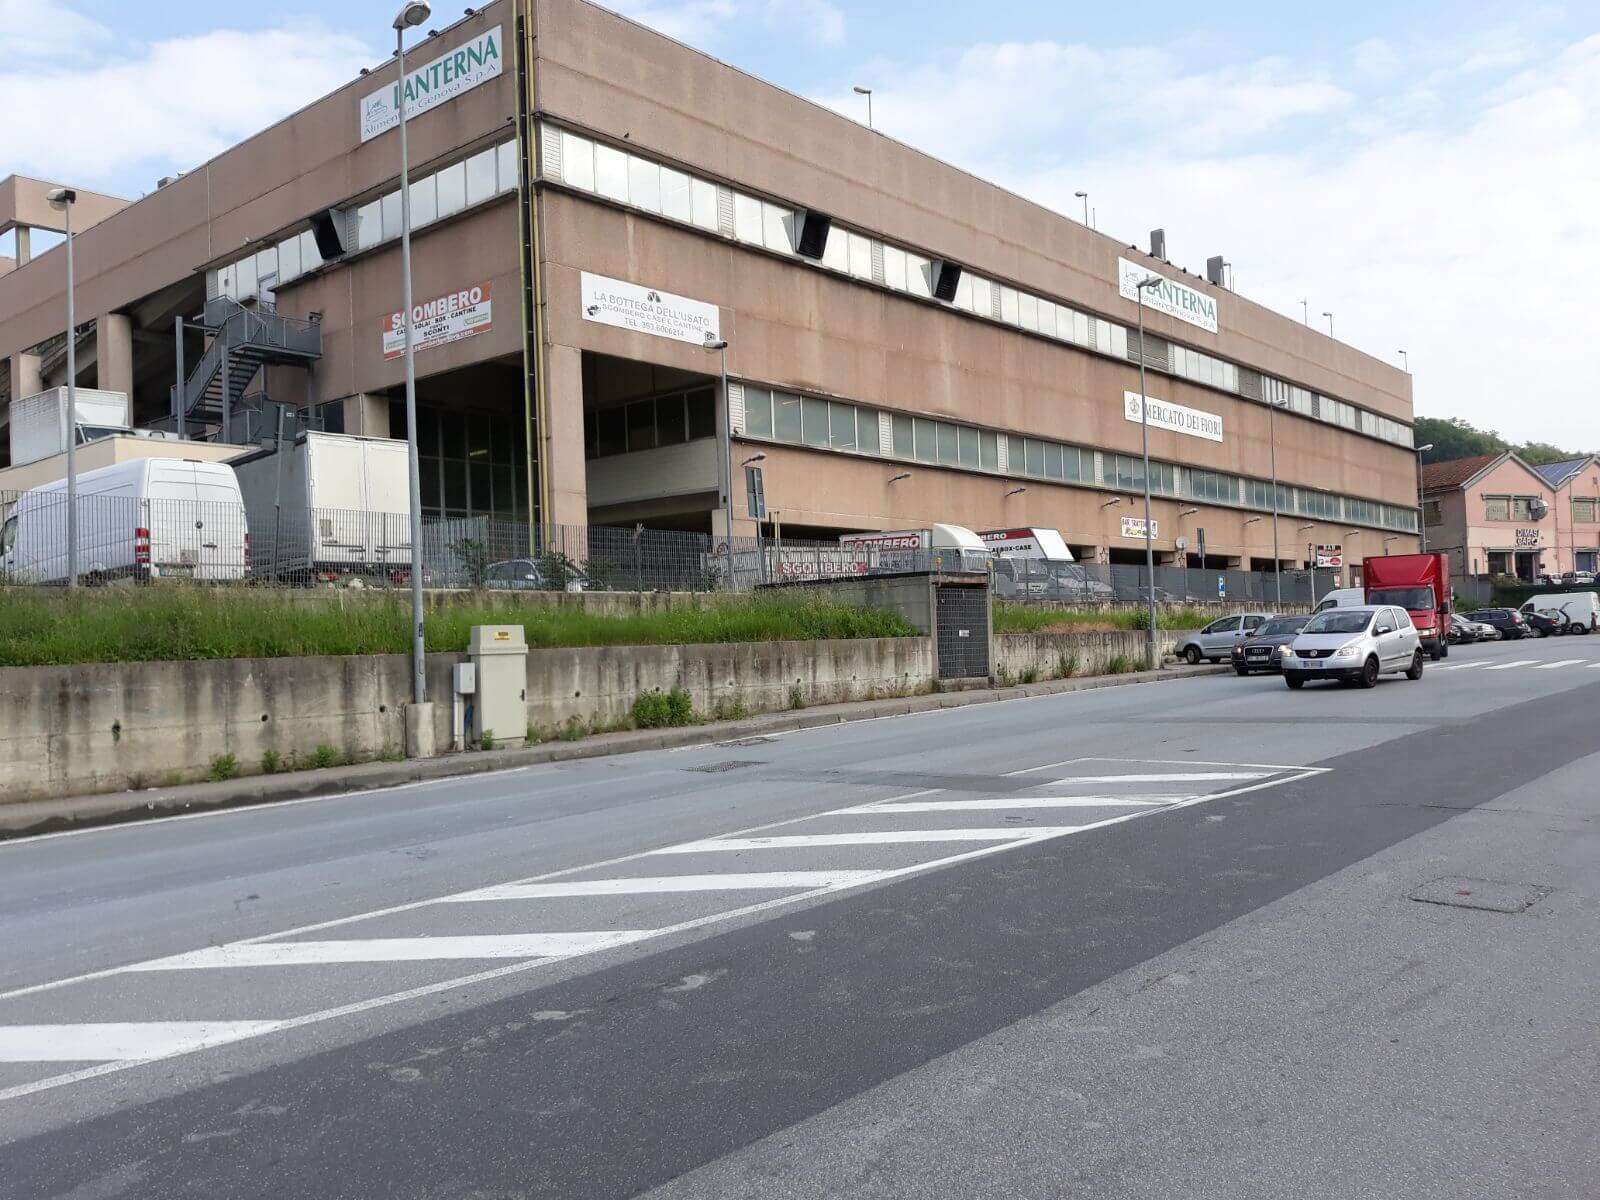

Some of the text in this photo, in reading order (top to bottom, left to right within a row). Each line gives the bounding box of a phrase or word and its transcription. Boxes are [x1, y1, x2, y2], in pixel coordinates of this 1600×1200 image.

[393, 35, 499, 110] LANTERNA
[364, 105, 415, 135] Alimenri
[417, 83, 461, 108] Genova
[391, 286, 482, 330] SOMBERO
[396, 325, 407, 336] CAS
[414, 320, 431, 331] SOLAI
[450, 306, 477, 320] CANTINE
[594, 291, 710, 327] LA BOTTEGA DELL'USATO
[423, 325, 450, 338] SCONTI
[1145, 402, 1222, 436] MERCATO DEI FIORI
[980, 532, 1007, 541] BERO
